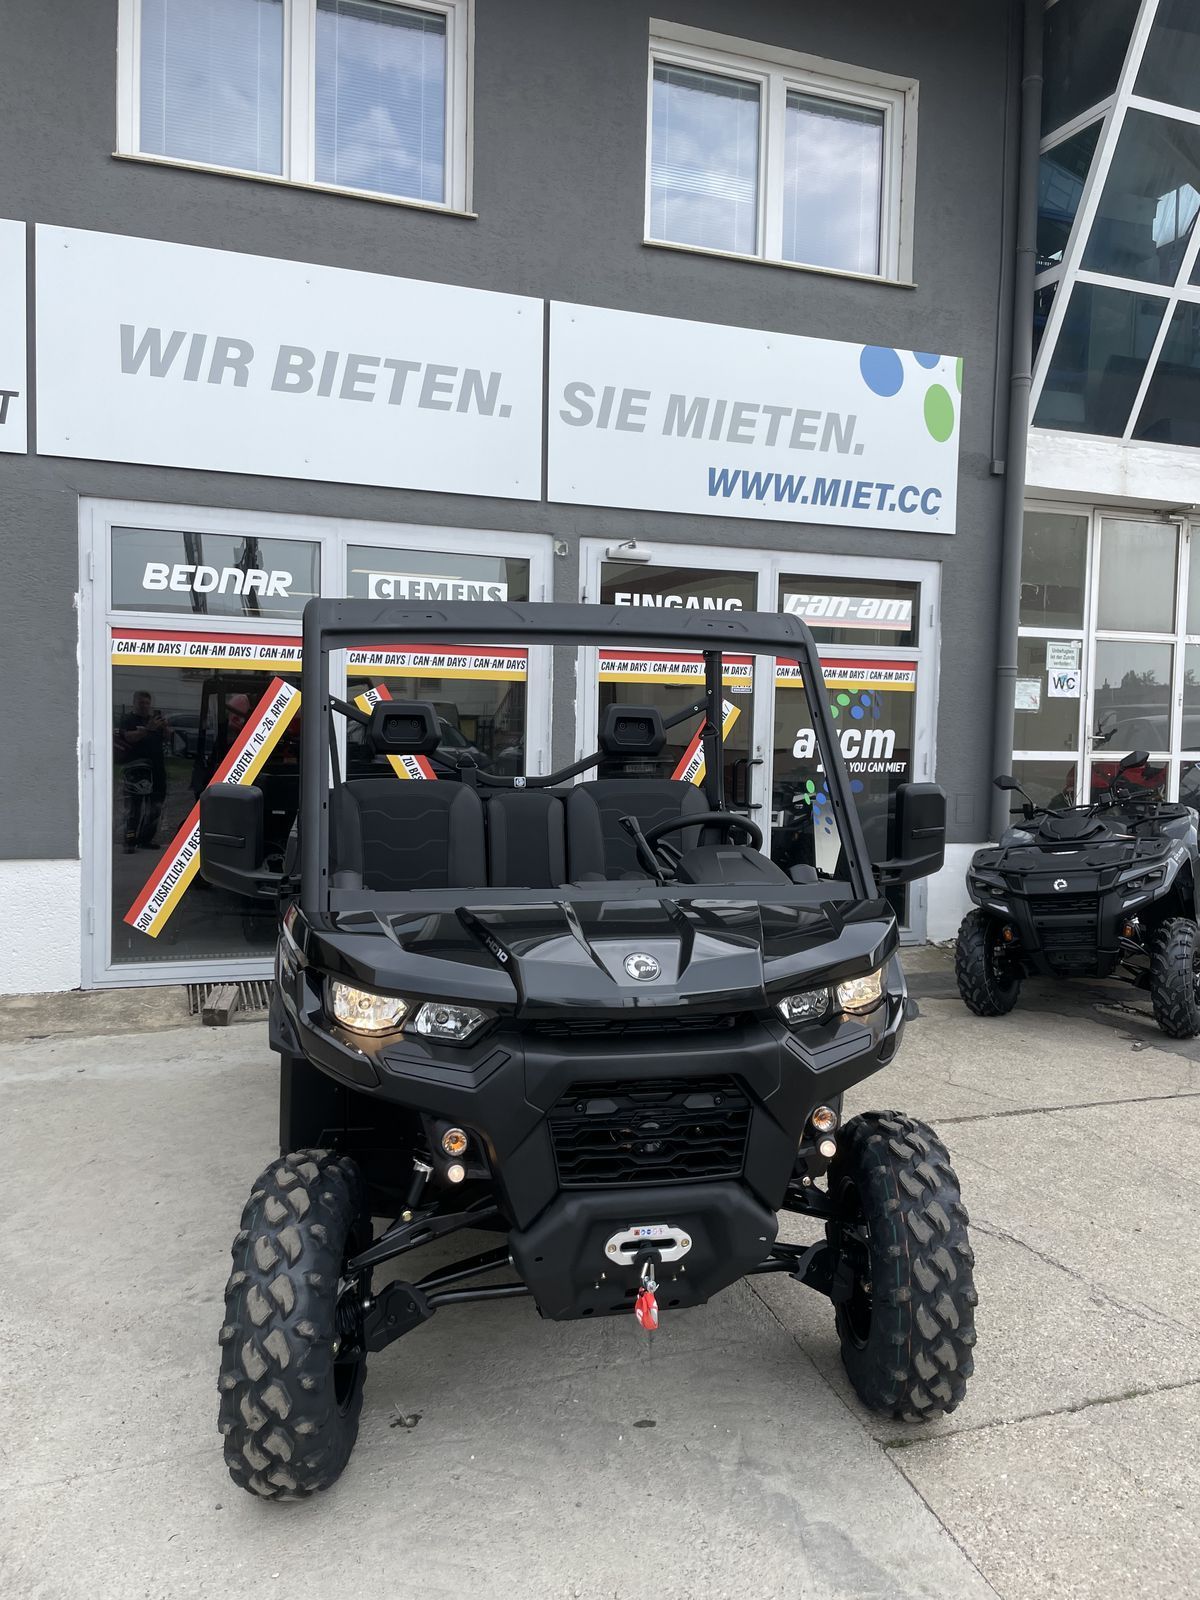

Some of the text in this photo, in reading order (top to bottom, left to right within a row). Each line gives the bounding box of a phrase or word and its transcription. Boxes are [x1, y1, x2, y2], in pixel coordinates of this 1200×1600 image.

[119, 323, 513, 419] WIR BIETEN.
[559, 380, 865, 456] SIE MIETEN.
[707, 466, 943, 516] WWW.MIET.CC
[142, 562, 293, 598] BEDNAR
[374, 578, 502, 601] CLEMENS
[116, 641, 155, 654] CAN-AM
[157, 643, 181, 655] DAYS
[189, 644, 226, 656] CAN-AM
[228, 645, 252, 658] DAYS
[259, 646, 295, 659] CAN-AM
[349, 652, 526, 670] CAN-AM DAYS CAN-AM DAYS CAN-AM DAYS
[600, 661, 629, 671] CAN-AM
[630, 662, 648, 672] DAYS
[652, 663, 680, 673] CAN-AM
[681, 664, 699, 674] DAYS
[731, 666, 748, 676] DAYS
[823, 669, 849, 679] CAN-AM
[849, 670, 865, 680] DAYS
[869, 671, 894, 681] CAN-AM
[894, 672, 910, 681] DAYS
[1053, 676, 1076, 690] WC
[792, 728, 896, 773] acm
[402, 756, 415, 767] ZU
[849, 762, 907, 773] YOU CAN MIET
[137, 912, 153, 931] 500
[147, 904, 158, 914] €
[180, 847, 194, 862] ZU
[270, 693, 290, 719] APRIL
